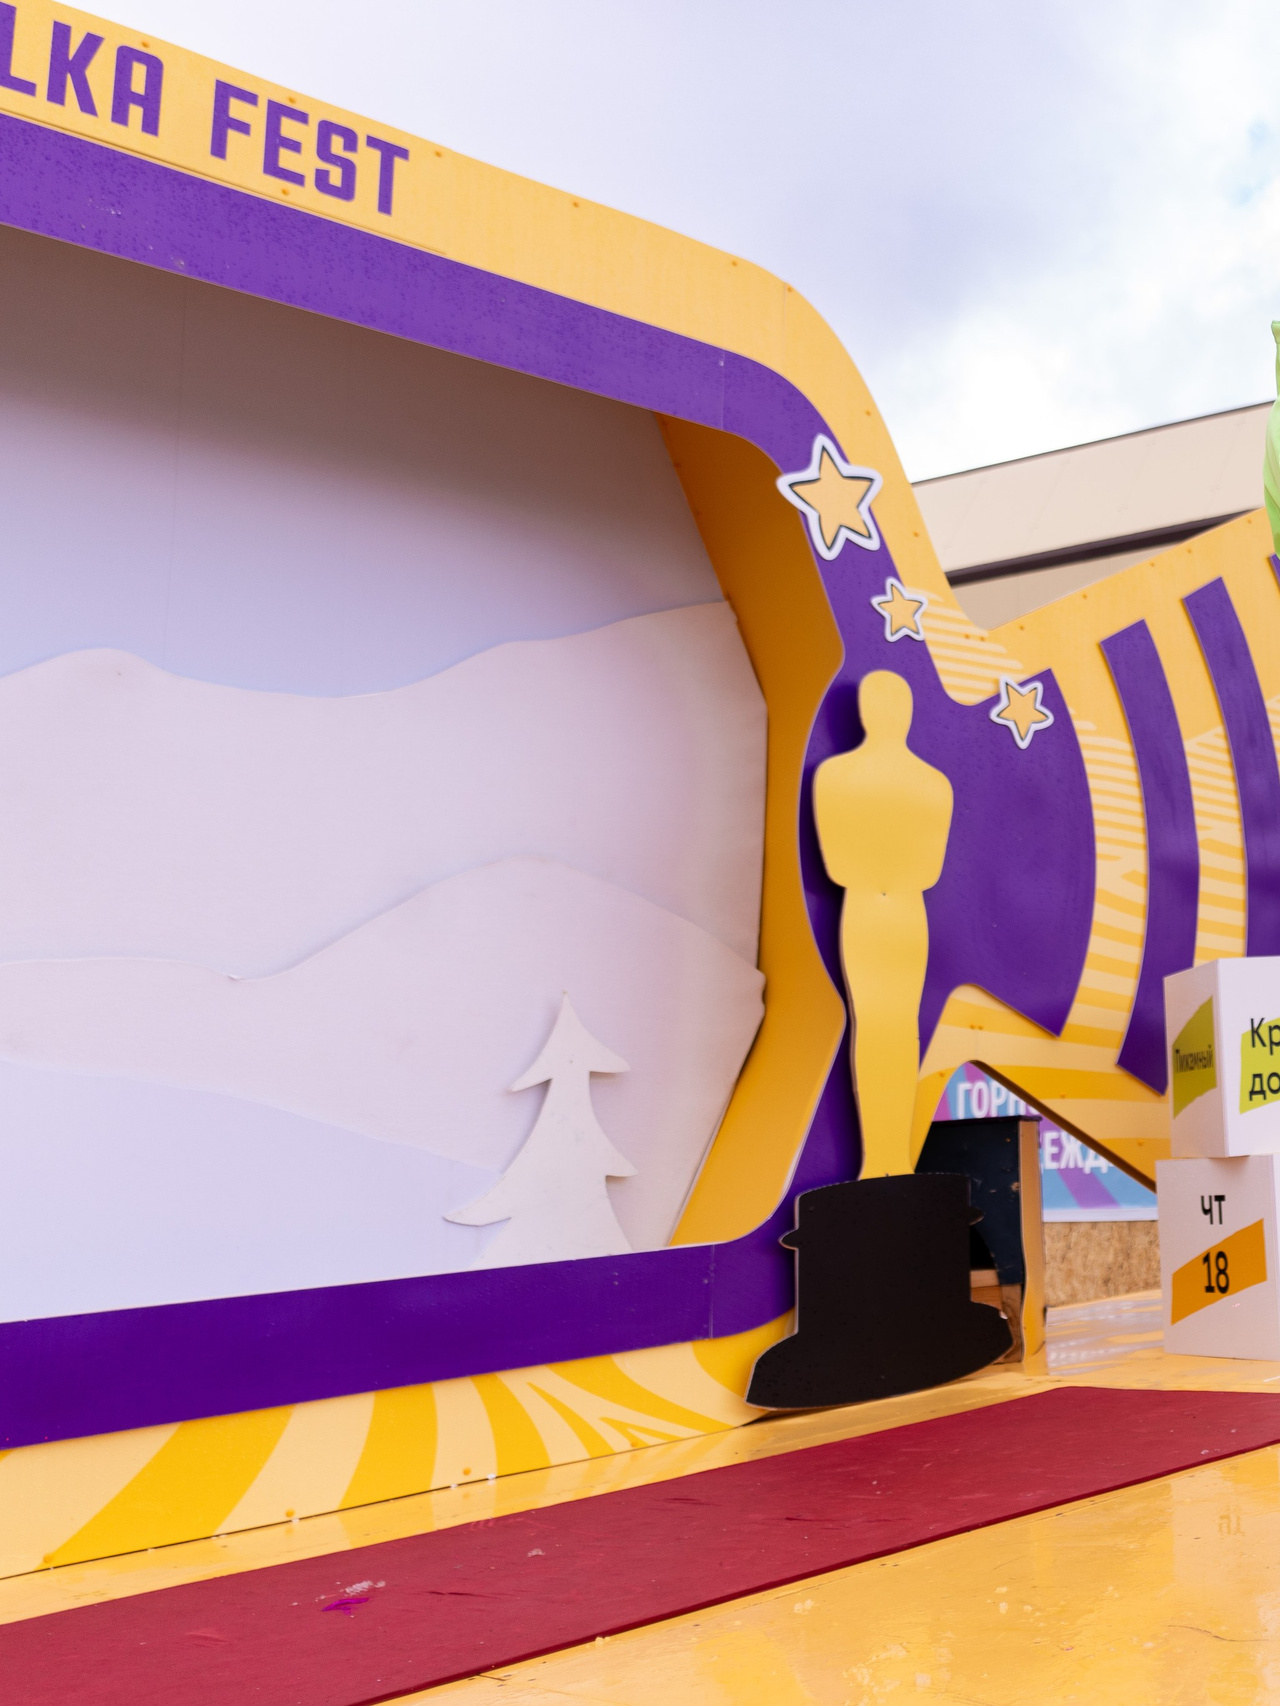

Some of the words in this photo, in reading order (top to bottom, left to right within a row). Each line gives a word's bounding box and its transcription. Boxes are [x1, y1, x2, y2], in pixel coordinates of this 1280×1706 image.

[210, 79, 410, 217] FEST
[957, 1081, 1041, 1118] ГОРН
[1201, 1194, 1226, 1225] ЧТ
[1202, 1251, 1229, 1294] 18
